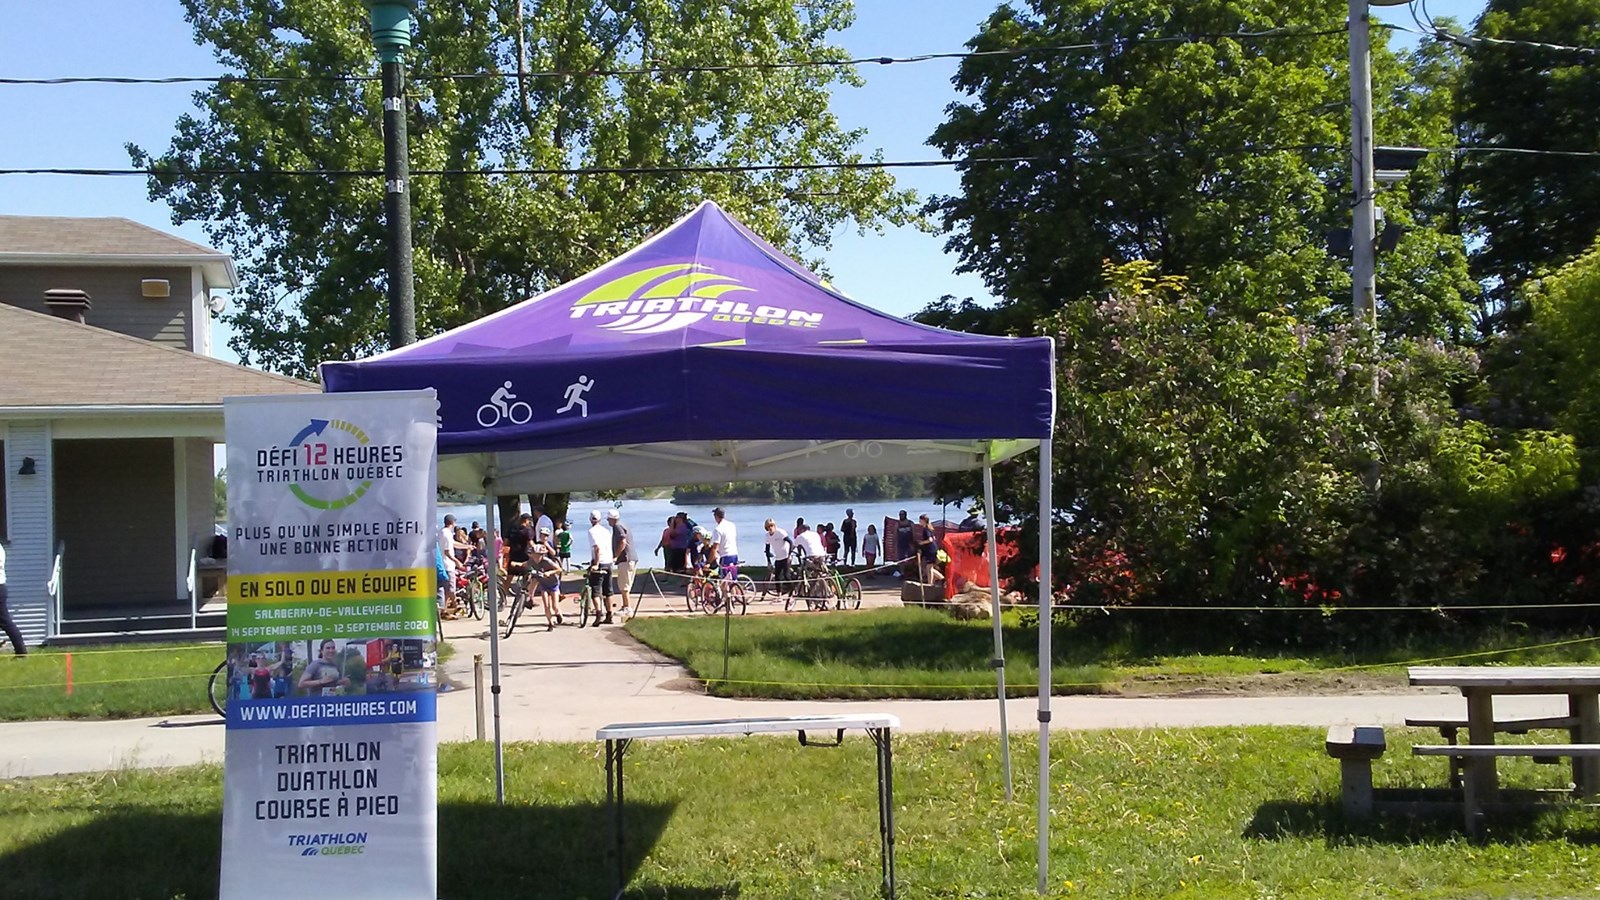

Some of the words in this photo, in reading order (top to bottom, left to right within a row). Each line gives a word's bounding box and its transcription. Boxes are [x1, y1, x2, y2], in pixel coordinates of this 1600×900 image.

[570, 297, 823, 322] TRIATHLON
[257, 446, 297, 467] DÉFI
[304, 443, 328, 465] 12
[334, 445, 402, 465] HEURES
[257, 468, 339, 482] TRIATHLON
[347, 464, 402, 480] QUÉBEC
[236, 527, 270, 540] PLUS
[278, 525, 320, 538] QU'UN
[328, 523, 380, 537] SIMPLE
[387, 518, 424, 535] DÉFI,
[260, 542, 287, 555] UNE
[294, 541, 340, 554] BONNE
[348, 538, 398, 552] ACTION
[240, 581, 258, 597] EN
[265, 579, 305, 597] SOLO
[311, 579, 331, 595] OU
[337, 577, 356, 595] EN
[362, 573, 417, 593] ÉQUIPE
[255, 605, 402, 619] SALABERRY-DE-VALLEYFIELD
[231, 628, 240, 636] 14
[242, 625, 297, 636] SEPTEMBRE
[301, 624, 323, 634] 2019
[334, 623, 344, 633] 12
[346, 622, 401, 633] SEPTEMBRE
[404, 620, 429, 630] 2020
[240, 700, 417, 720] WWW.DEFI12HEURES.COM
[275, 741, 380, 764] TRIATHLON
[277, 769, 378, 792] DUATHLON
[256, 798, 330, 820] COURSE
[338, 792, 349, 816] À
[356, 795, 399, 816] PIED
[288, 832, 367, 846] TRIATHLON
